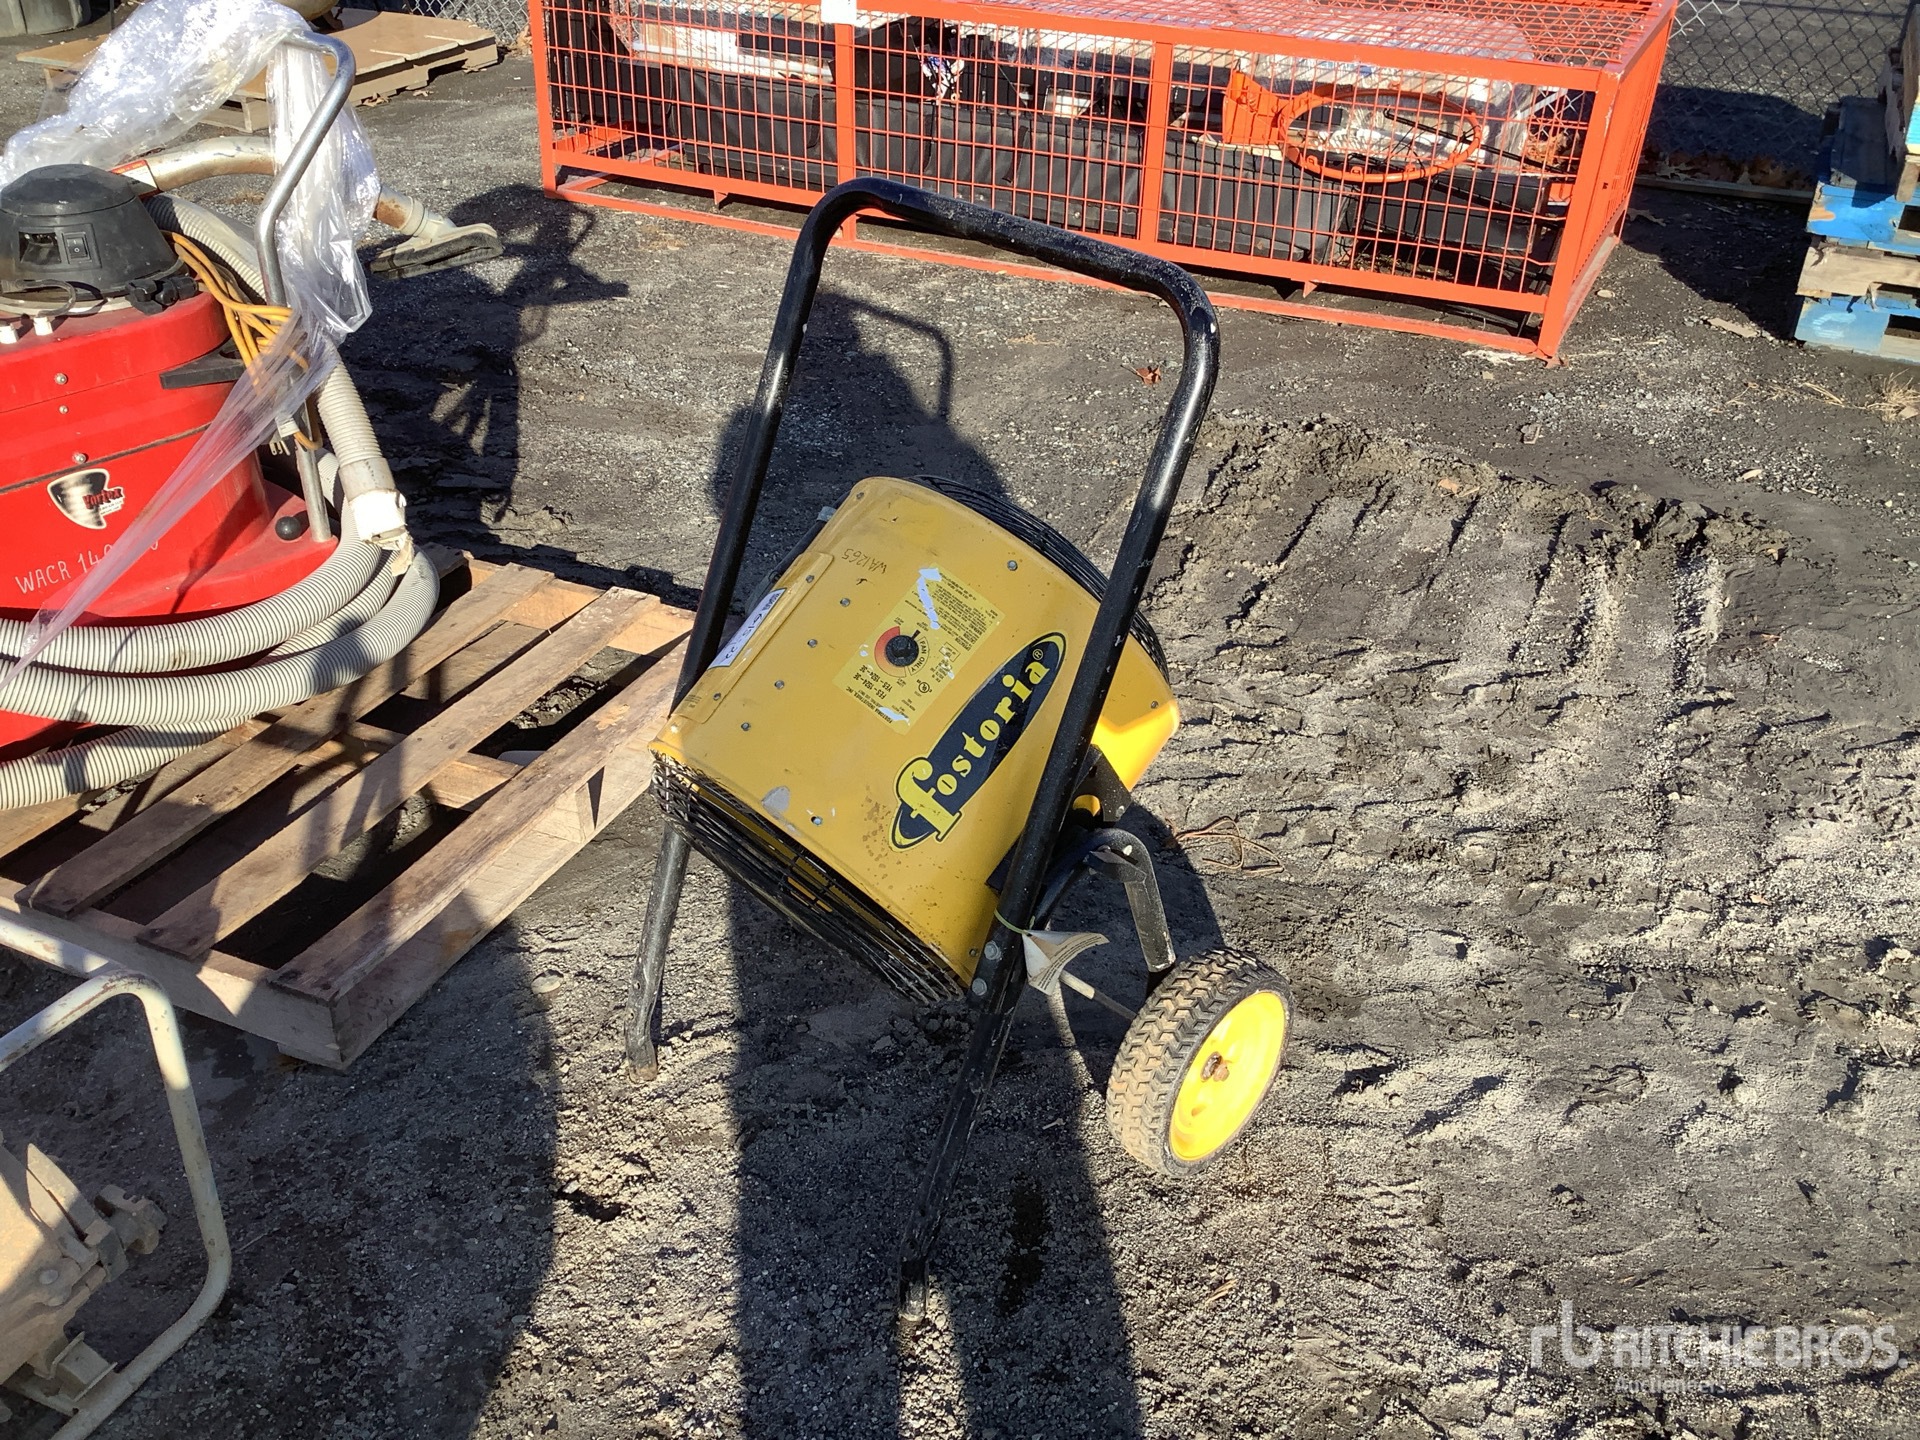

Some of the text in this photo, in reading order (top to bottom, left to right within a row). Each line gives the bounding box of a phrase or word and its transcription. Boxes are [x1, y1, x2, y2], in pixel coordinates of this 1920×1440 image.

[841, 548, 887, 574] WA1265
[15, 560, 71, 593] WACR
[911, 656, 925, 672] ONLY
[897, 661, 1050, 841] fostoria
